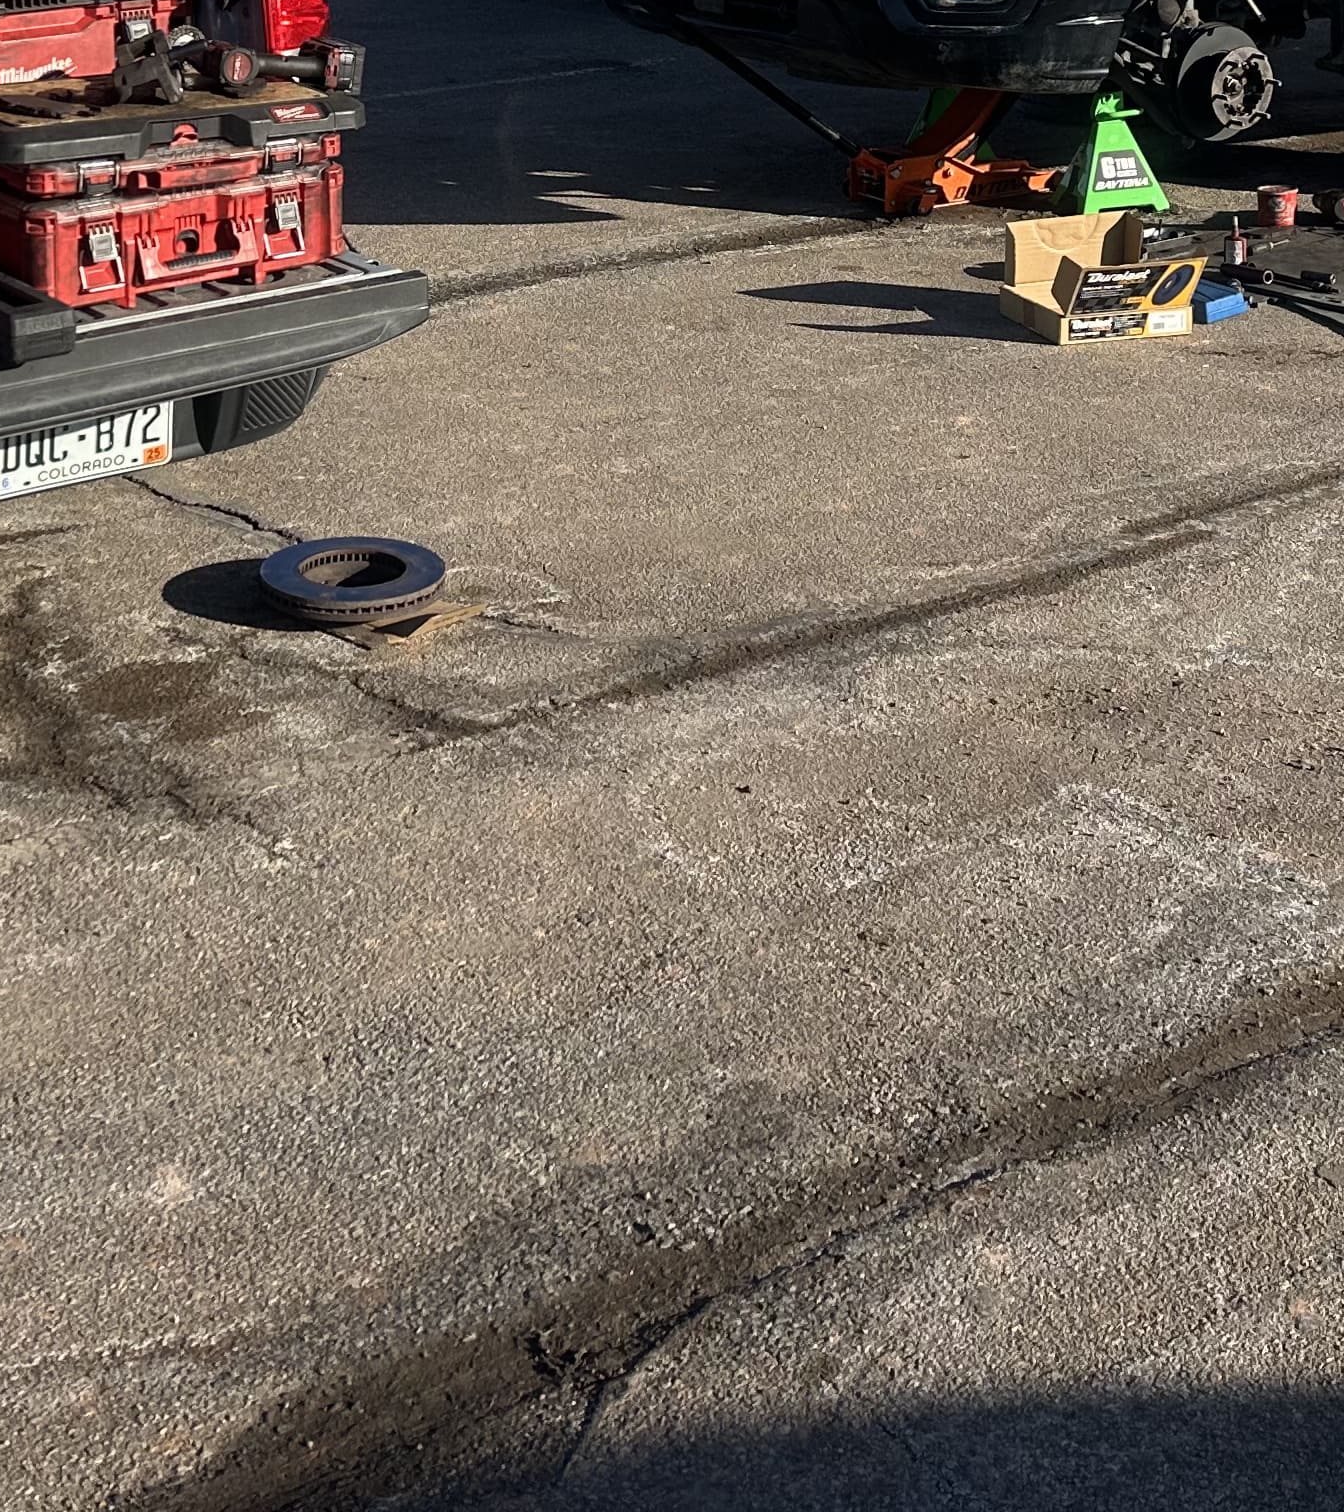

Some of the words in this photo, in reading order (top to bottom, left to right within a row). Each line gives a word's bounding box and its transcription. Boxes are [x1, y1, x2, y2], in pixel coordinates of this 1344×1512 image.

[1100, 156, 1117, 179] 6
[1114, 156, 1137, 170] TON
[1094, 176, 1149, 191] DAYTONA
[1087, 268, 1151, 283] Duralast
[146, 448, 161, 459] 25
[37, 454, 125, 482] COLORADO
